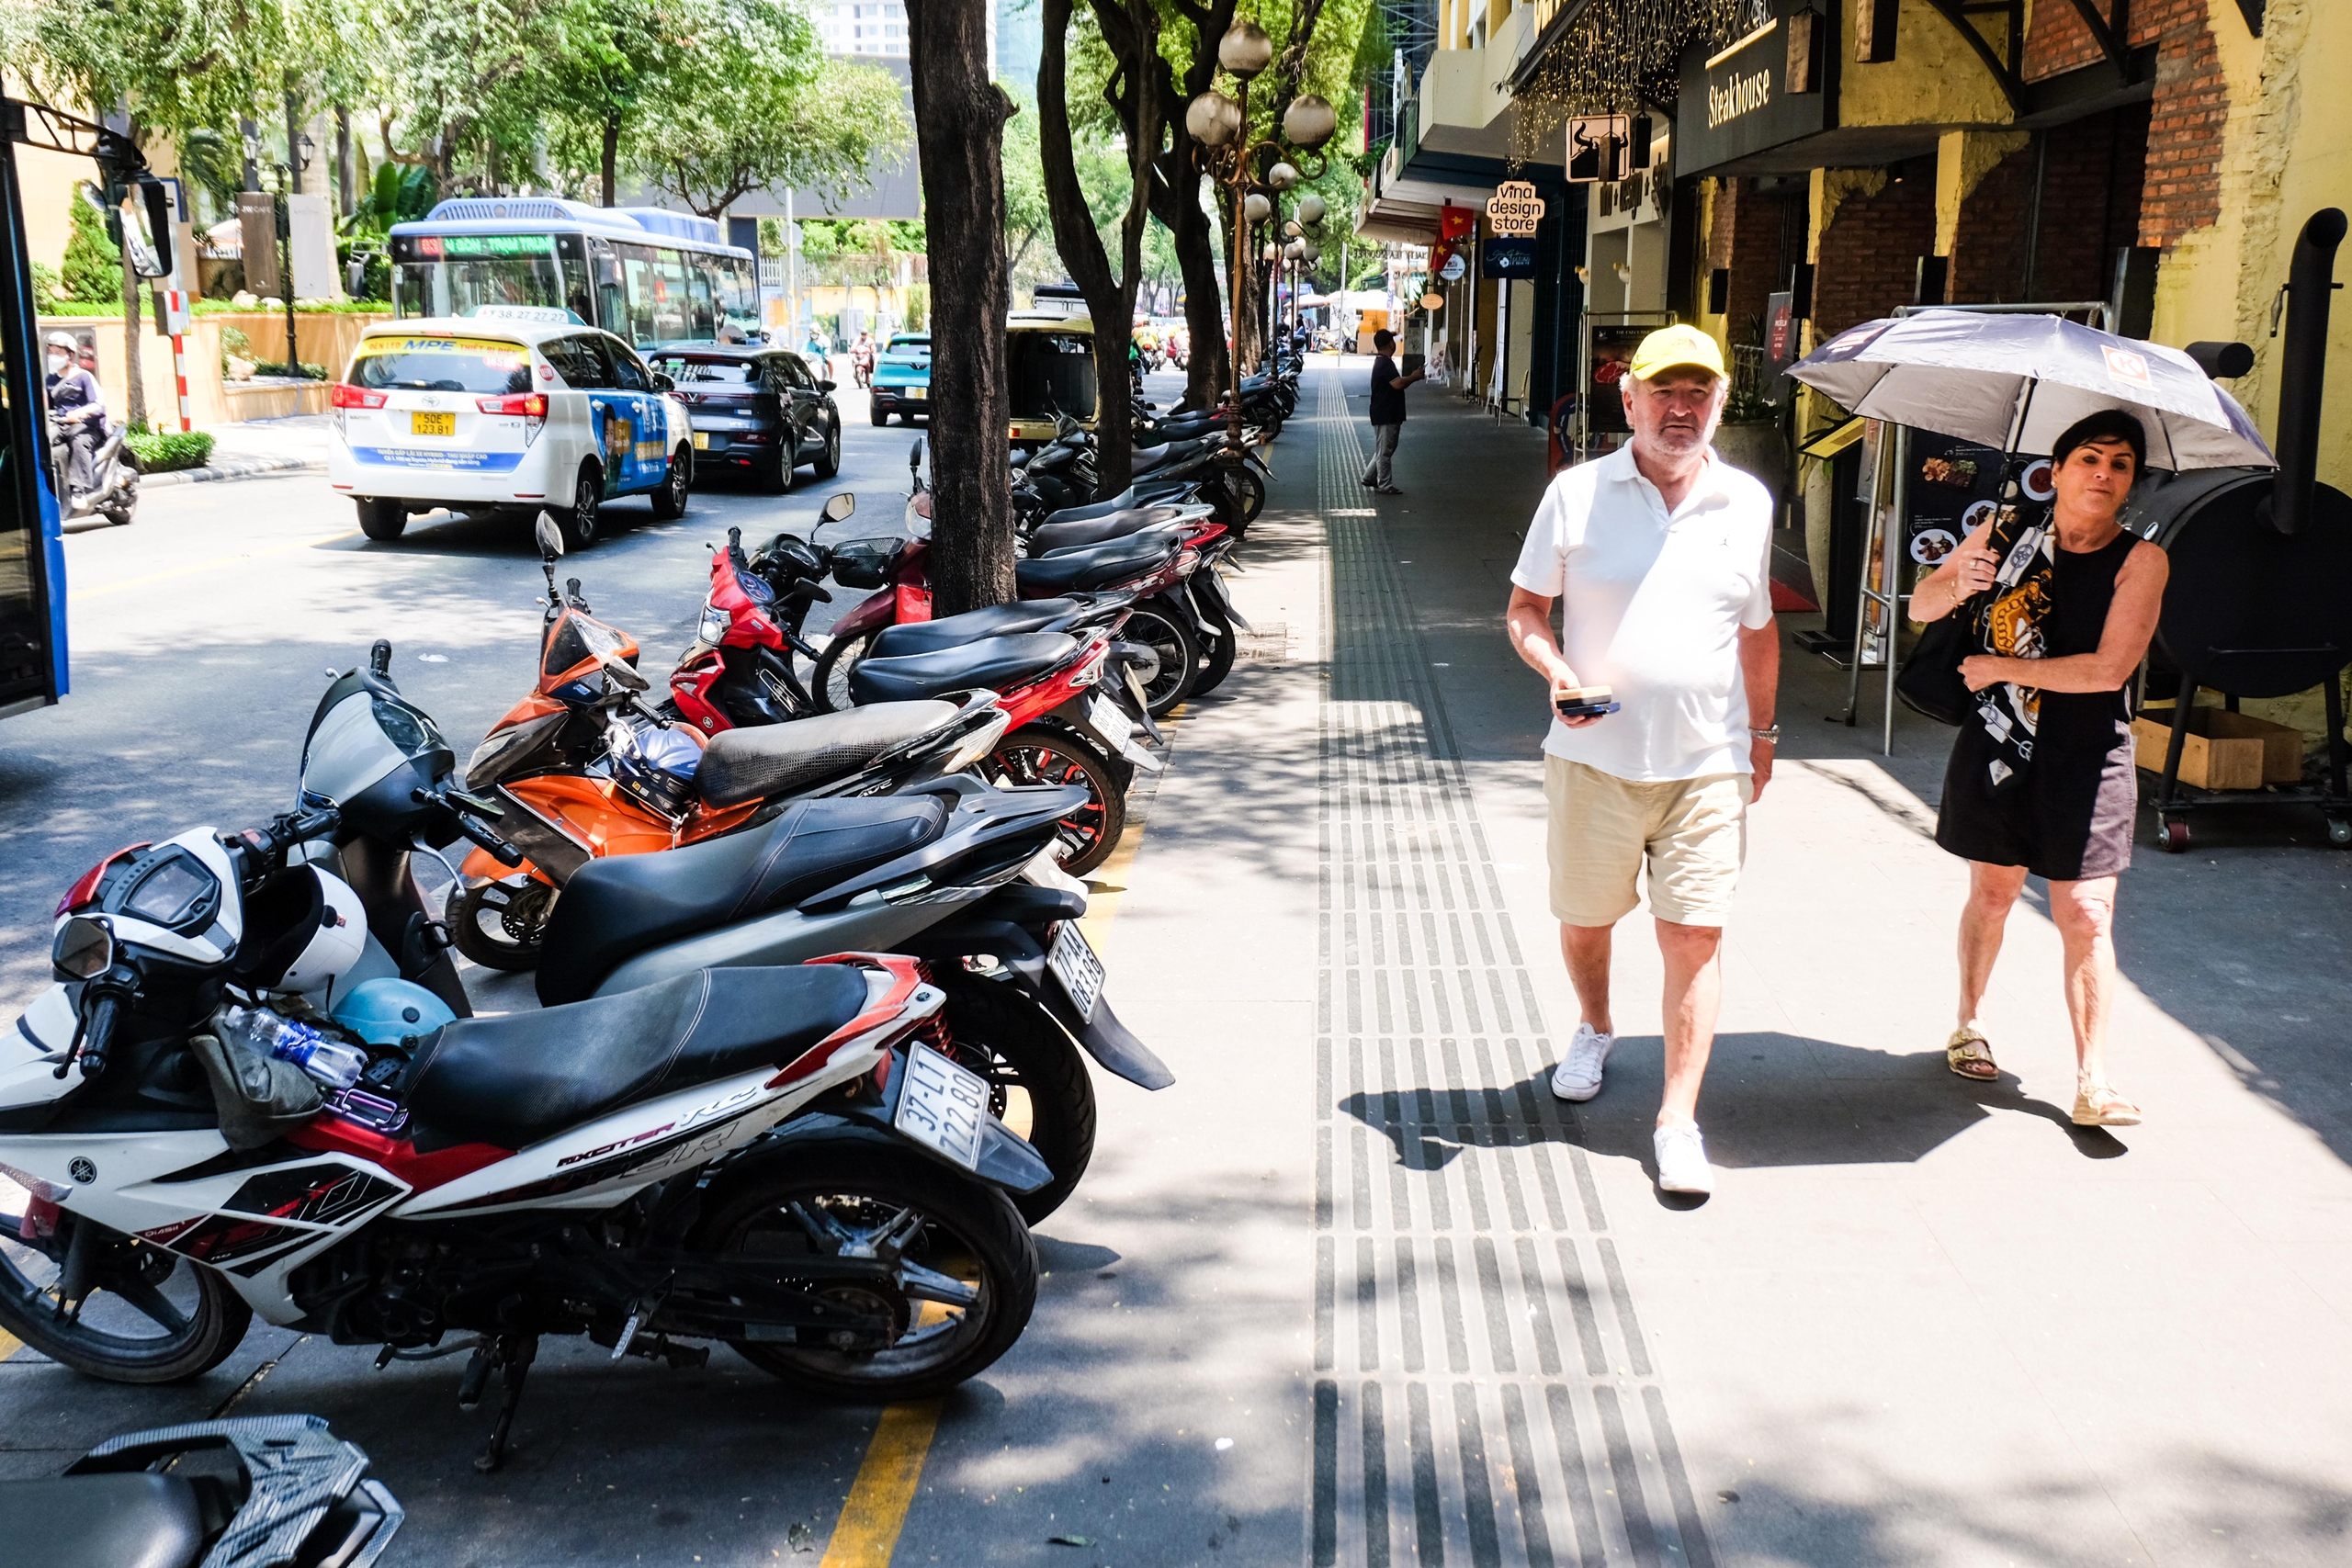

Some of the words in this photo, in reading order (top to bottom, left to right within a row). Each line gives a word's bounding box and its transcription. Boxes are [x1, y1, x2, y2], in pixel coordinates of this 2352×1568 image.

[1709, 68, 1770, 130] Steakhouse
[1500, 184, 1532, 198] vina
[1490, 198, 1541, 219] design
[1494, 215, 1534, 231] store
[517, 310, 531, 320] 27
[534, 311, 548, 320] 27
[550, 312, 565, 321] 27
[386, 341, 401, 349] LED
[403, 339, 458, 351] MPE
[416, 425, 449, 434] 123.81
[424, 414, 442, 424] 50E
[1054, 927, 1083, 983] 77-AA
[1071, 950, 1101, 1015] 083.86
[905, 1060, 946, 1132] 37-L1
[681, 1087, 757, 1127] RC
[938, 1073, 981, 1157] 722.80
